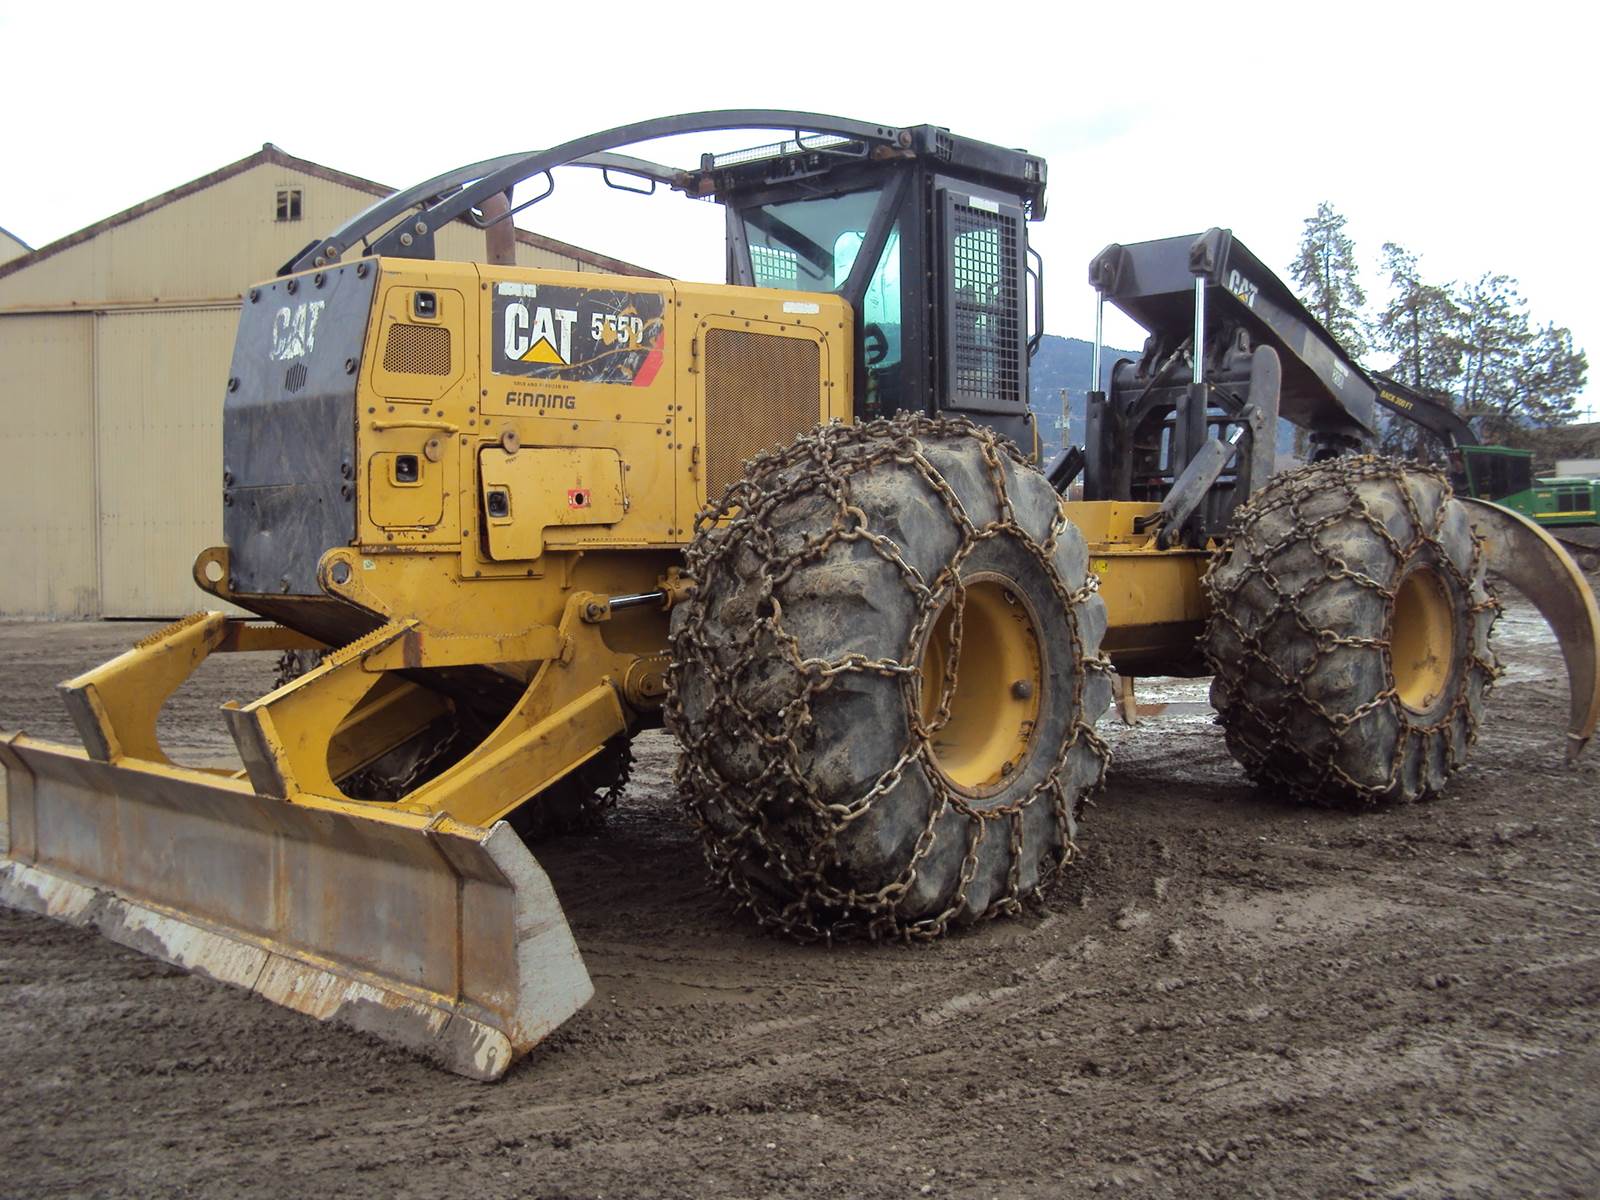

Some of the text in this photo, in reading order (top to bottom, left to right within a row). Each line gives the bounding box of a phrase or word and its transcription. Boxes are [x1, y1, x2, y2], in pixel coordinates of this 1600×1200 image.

[1229, 269, 1258, 307] CAT
[270, 300, 325, 360] CAT
[504, 303, 577, 365] CAT
